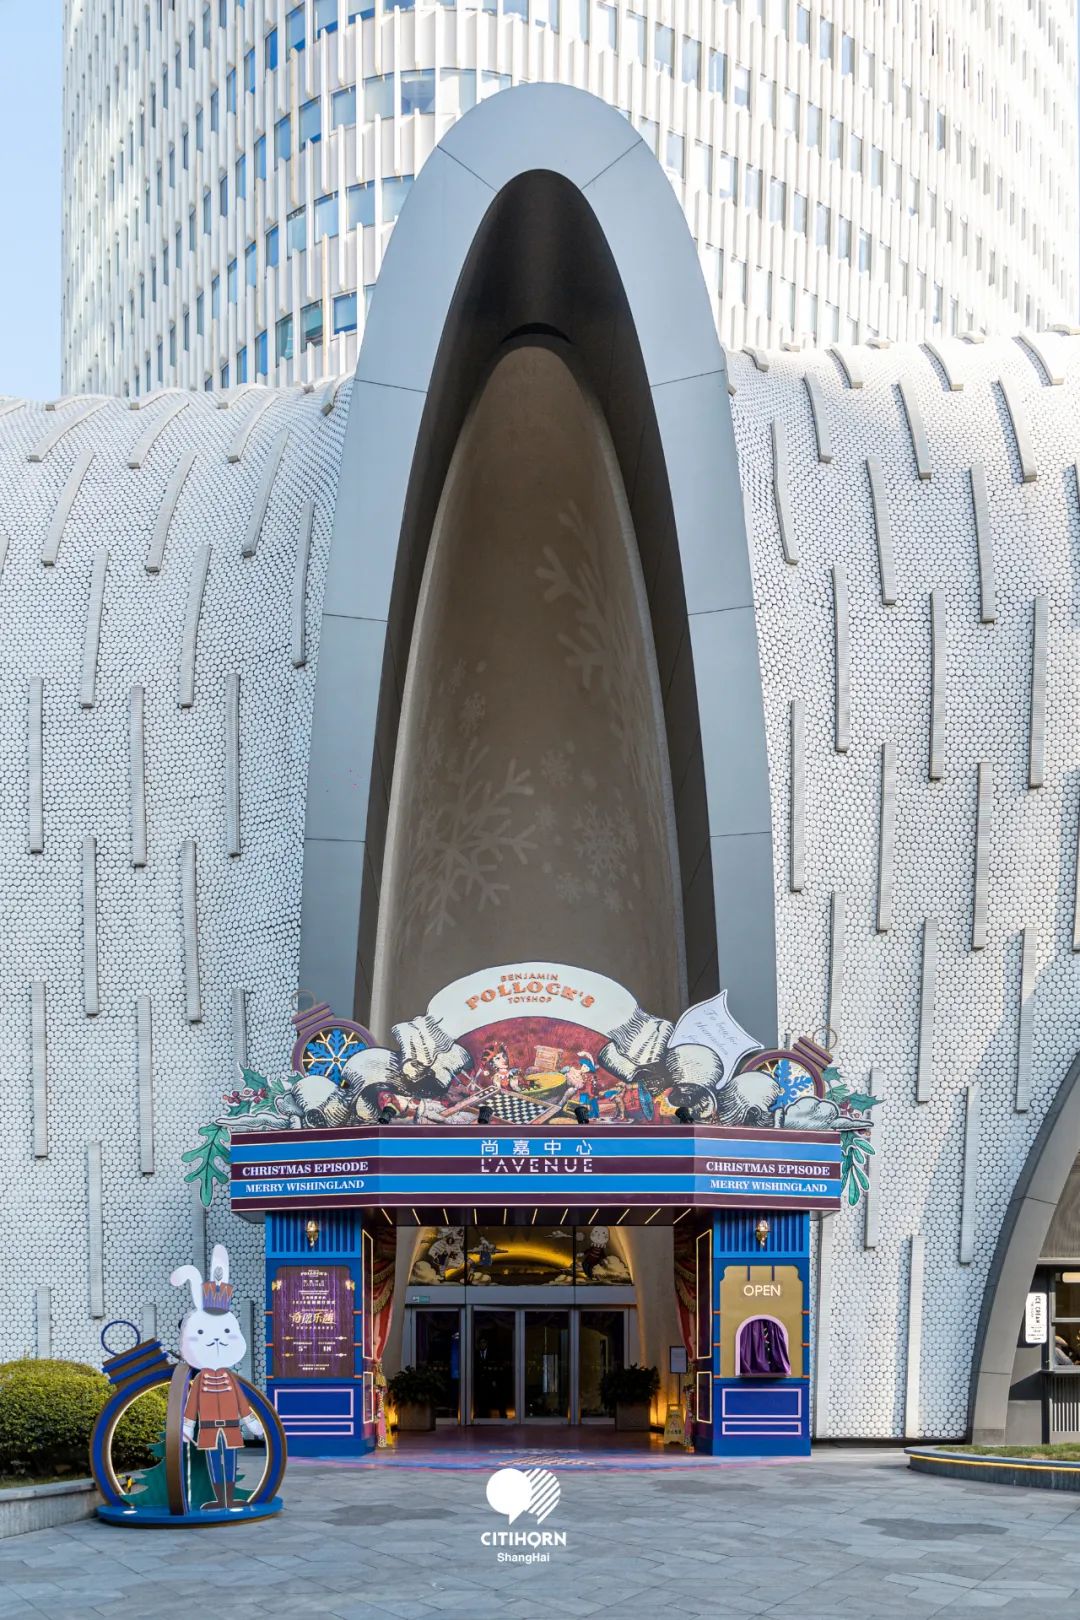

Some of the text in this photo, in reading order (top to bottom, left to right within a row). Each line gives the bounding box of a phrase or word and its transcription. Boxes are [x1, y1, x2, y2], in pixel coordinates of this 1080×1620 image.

[501, 973, 559, 982] BENJAMIN
[465, 981, 595, 1010] POLLOCK'S
[508, 996, 552, 1005] TOYSHOP
[481, 1140, 593, 1156] 尚嘉中心
[242, 1161, 369, 1177] CHRISTMAS EPISODE
[481, 1158, 593, 1173] L'AVENUE
[706, 1161, 830, 1176] CHRISTMAS EPISODE
[246, 1180, 365, 1193] MERRY WISHINGLAND
[710, 1179, 828, 1193] MERRY WISHINGLAND
[743, 1284, 781, 1297] OPEN
